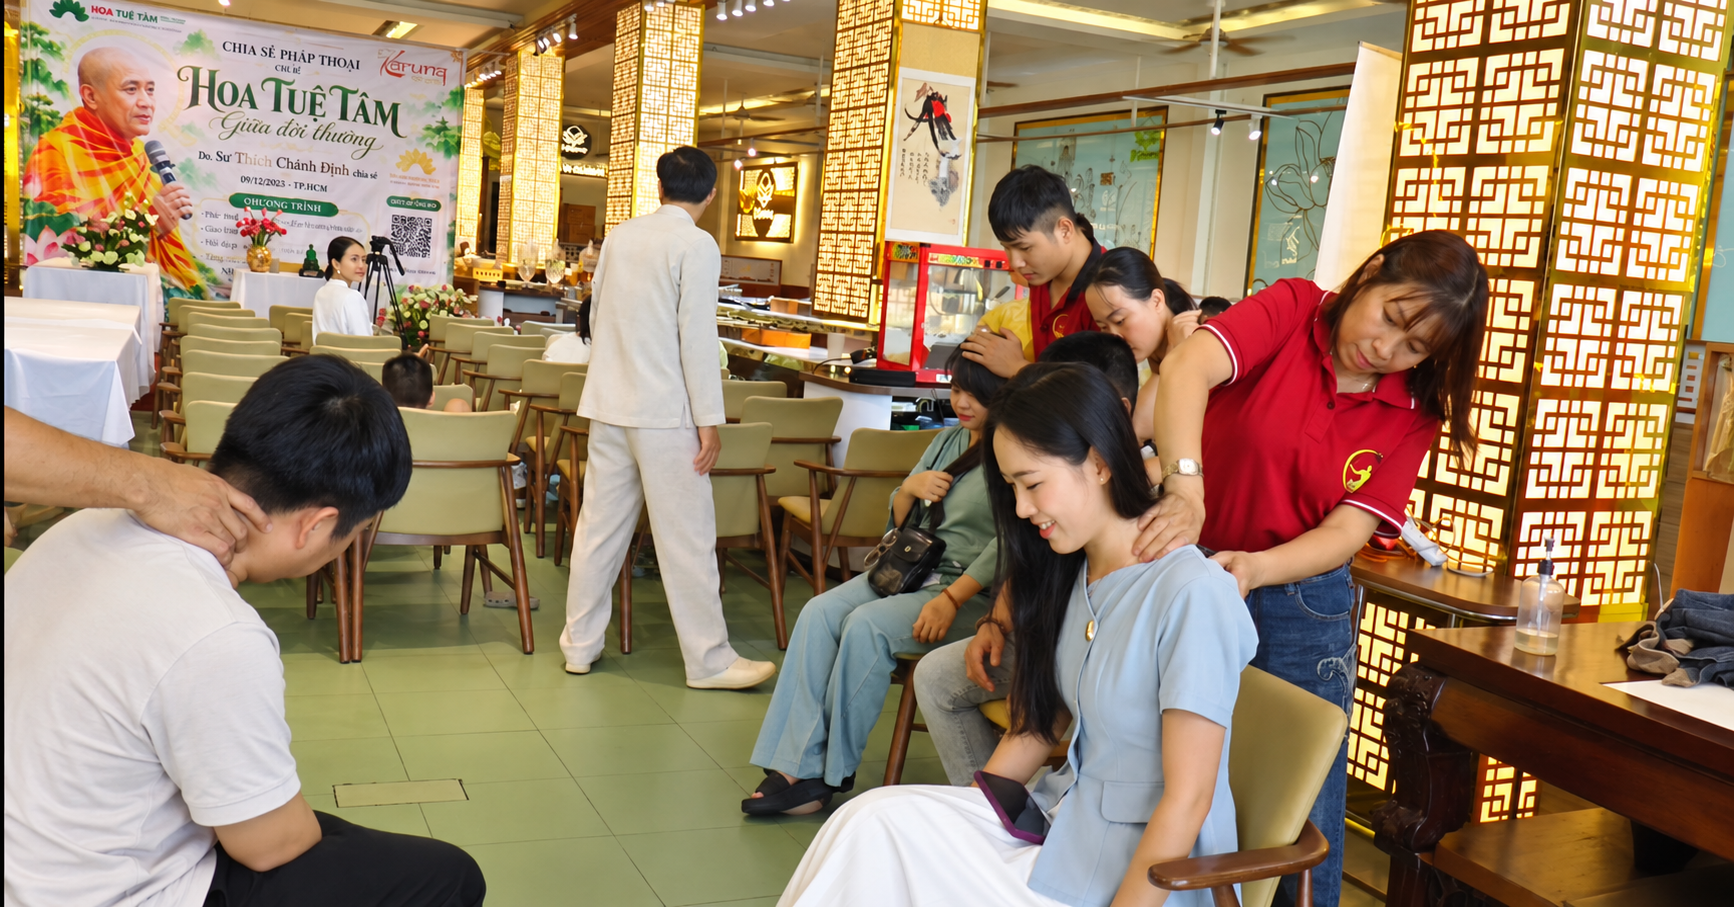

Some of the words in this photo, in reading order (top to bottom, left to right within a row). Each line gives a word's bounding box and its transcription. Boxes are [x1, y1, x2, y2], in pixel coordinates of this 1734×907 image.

[91, 5, 113, 16] HOA
[222, 41, 257, 56] CHIA
[318, 55, 361, 72] THOẠI
[177, 65, 259, 113] HOA
[261, 77, 327, 122] TUỆ
[329, 85, 408, 138] TÂM
[276, 156, 317, 173] Chánh
[320, 162, 350, 178] Định
[240, 175, 286, 188] 09/12/2023
[294, 181, 328, 193] TP.HCM
